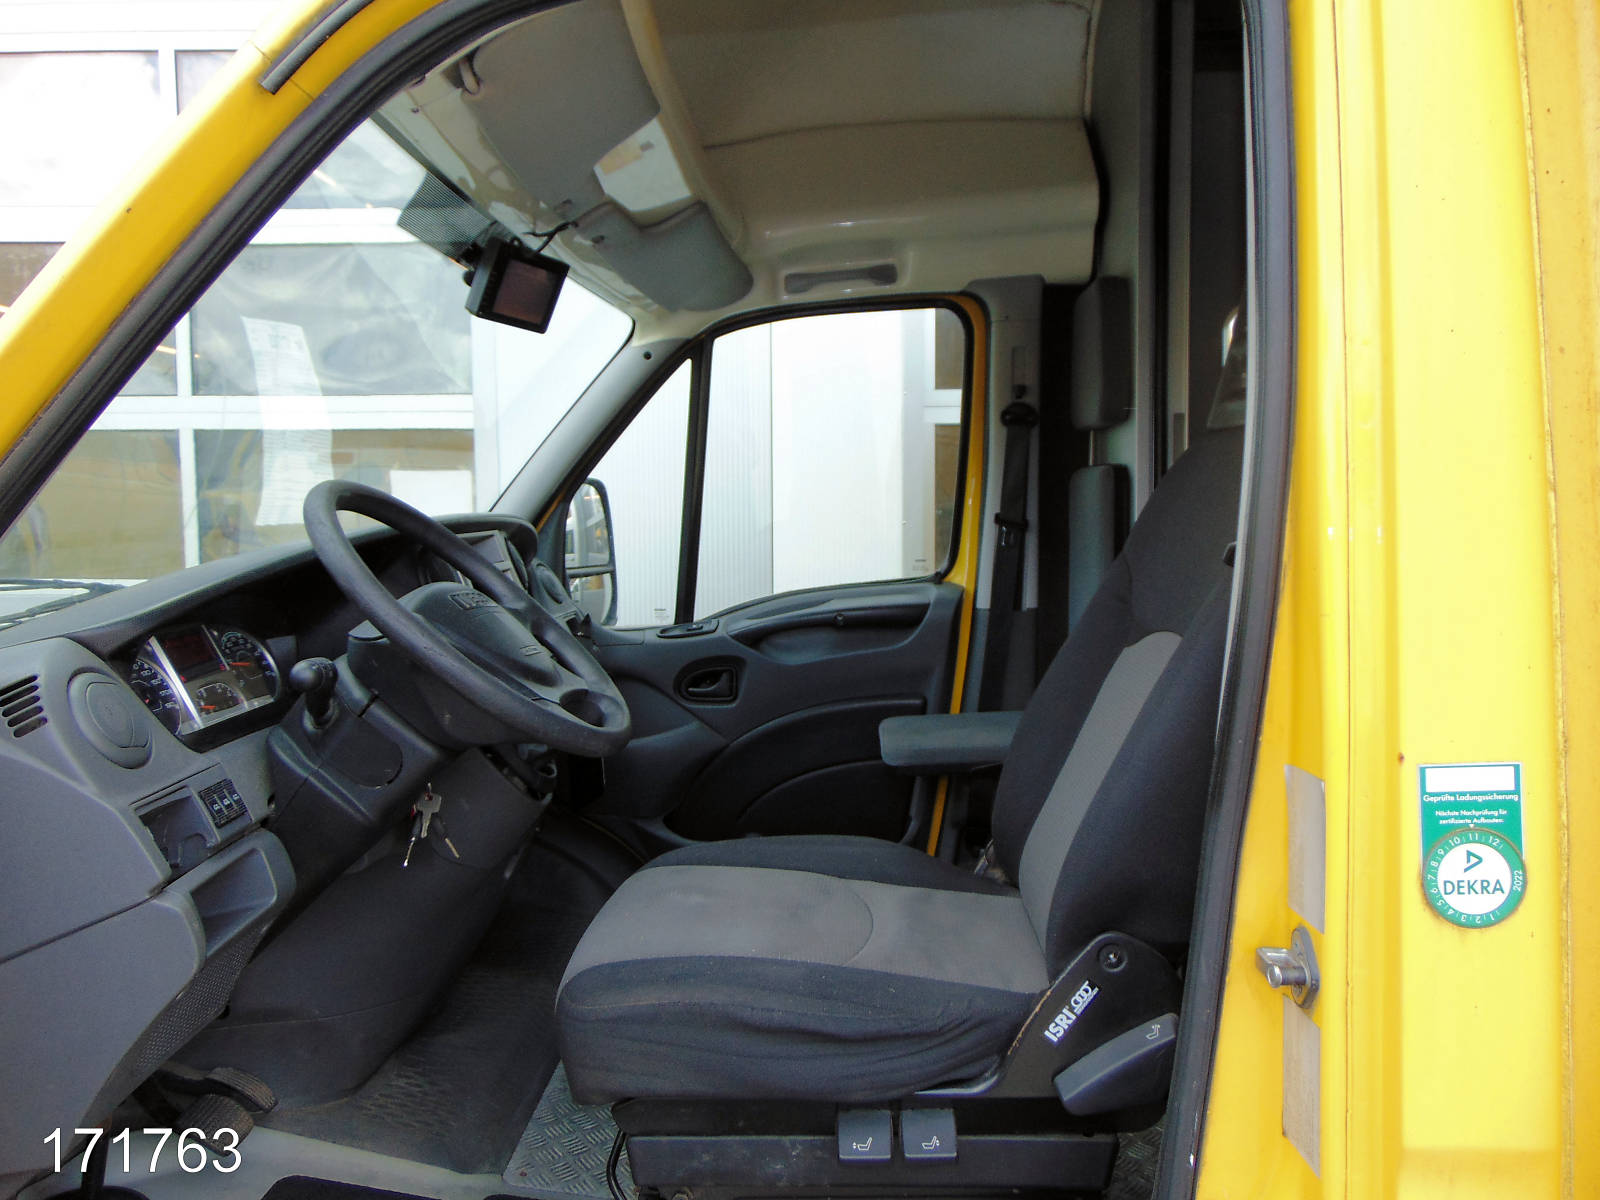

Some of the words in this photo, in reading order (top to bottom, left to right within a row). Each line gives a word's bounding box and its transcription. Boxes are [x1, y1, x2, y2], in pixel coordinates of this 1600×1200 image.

[1448, 836, 1461, 846] 10
[1469, 832, 1478, 841] 11
[1488, 835, 1500, 846] 12
[1513, 870, 1523, 892] 2022
[1443, 879, 1505, 895] DEKRA
[1461, 914, 1467, 922] 3
[1475, 915, 1482, 924] 2
[1044, 1007, 1077, 1042] ISRI
